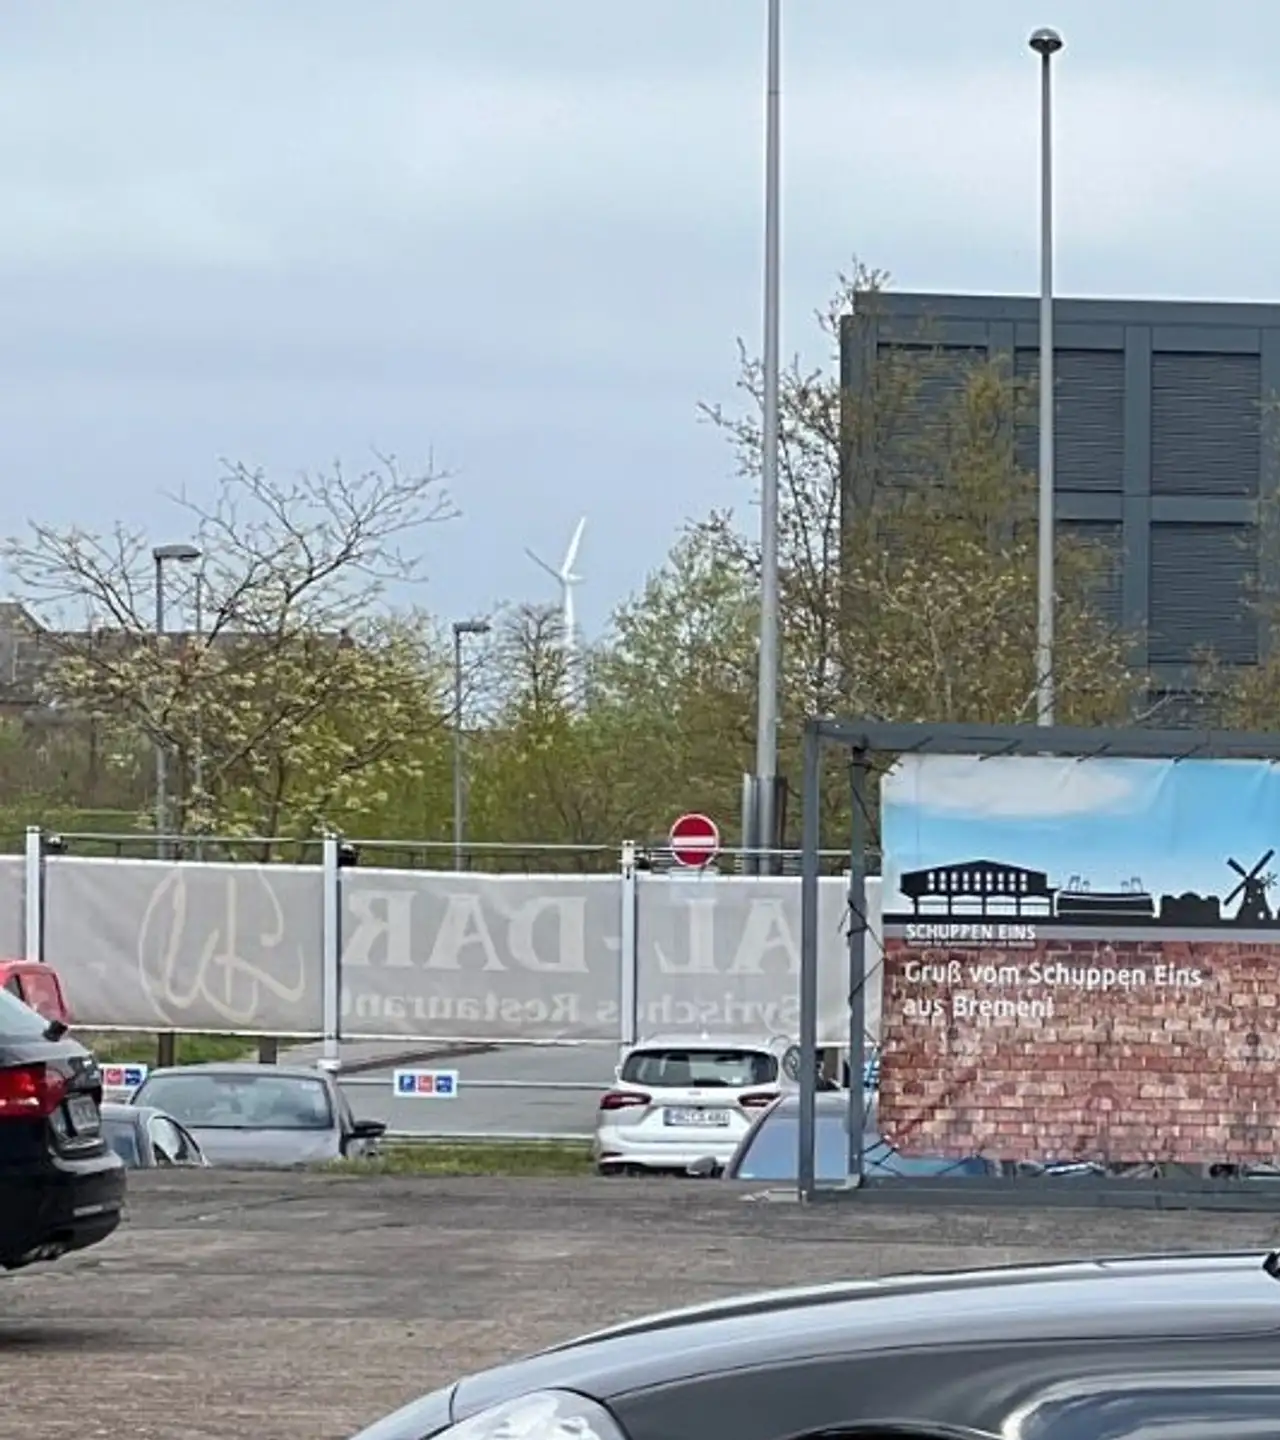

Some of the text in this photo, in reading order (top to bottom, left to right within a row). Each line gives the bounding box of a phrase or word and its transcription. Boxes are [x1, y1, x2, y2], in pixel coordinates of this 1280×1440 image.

[905, 924, 1036, 941] SCHUPPEN EINS
[904, 960, 1202, 990] Gruß vom Schuppen Eins
[902, 995, 1053, 1018] aus Bremen!
